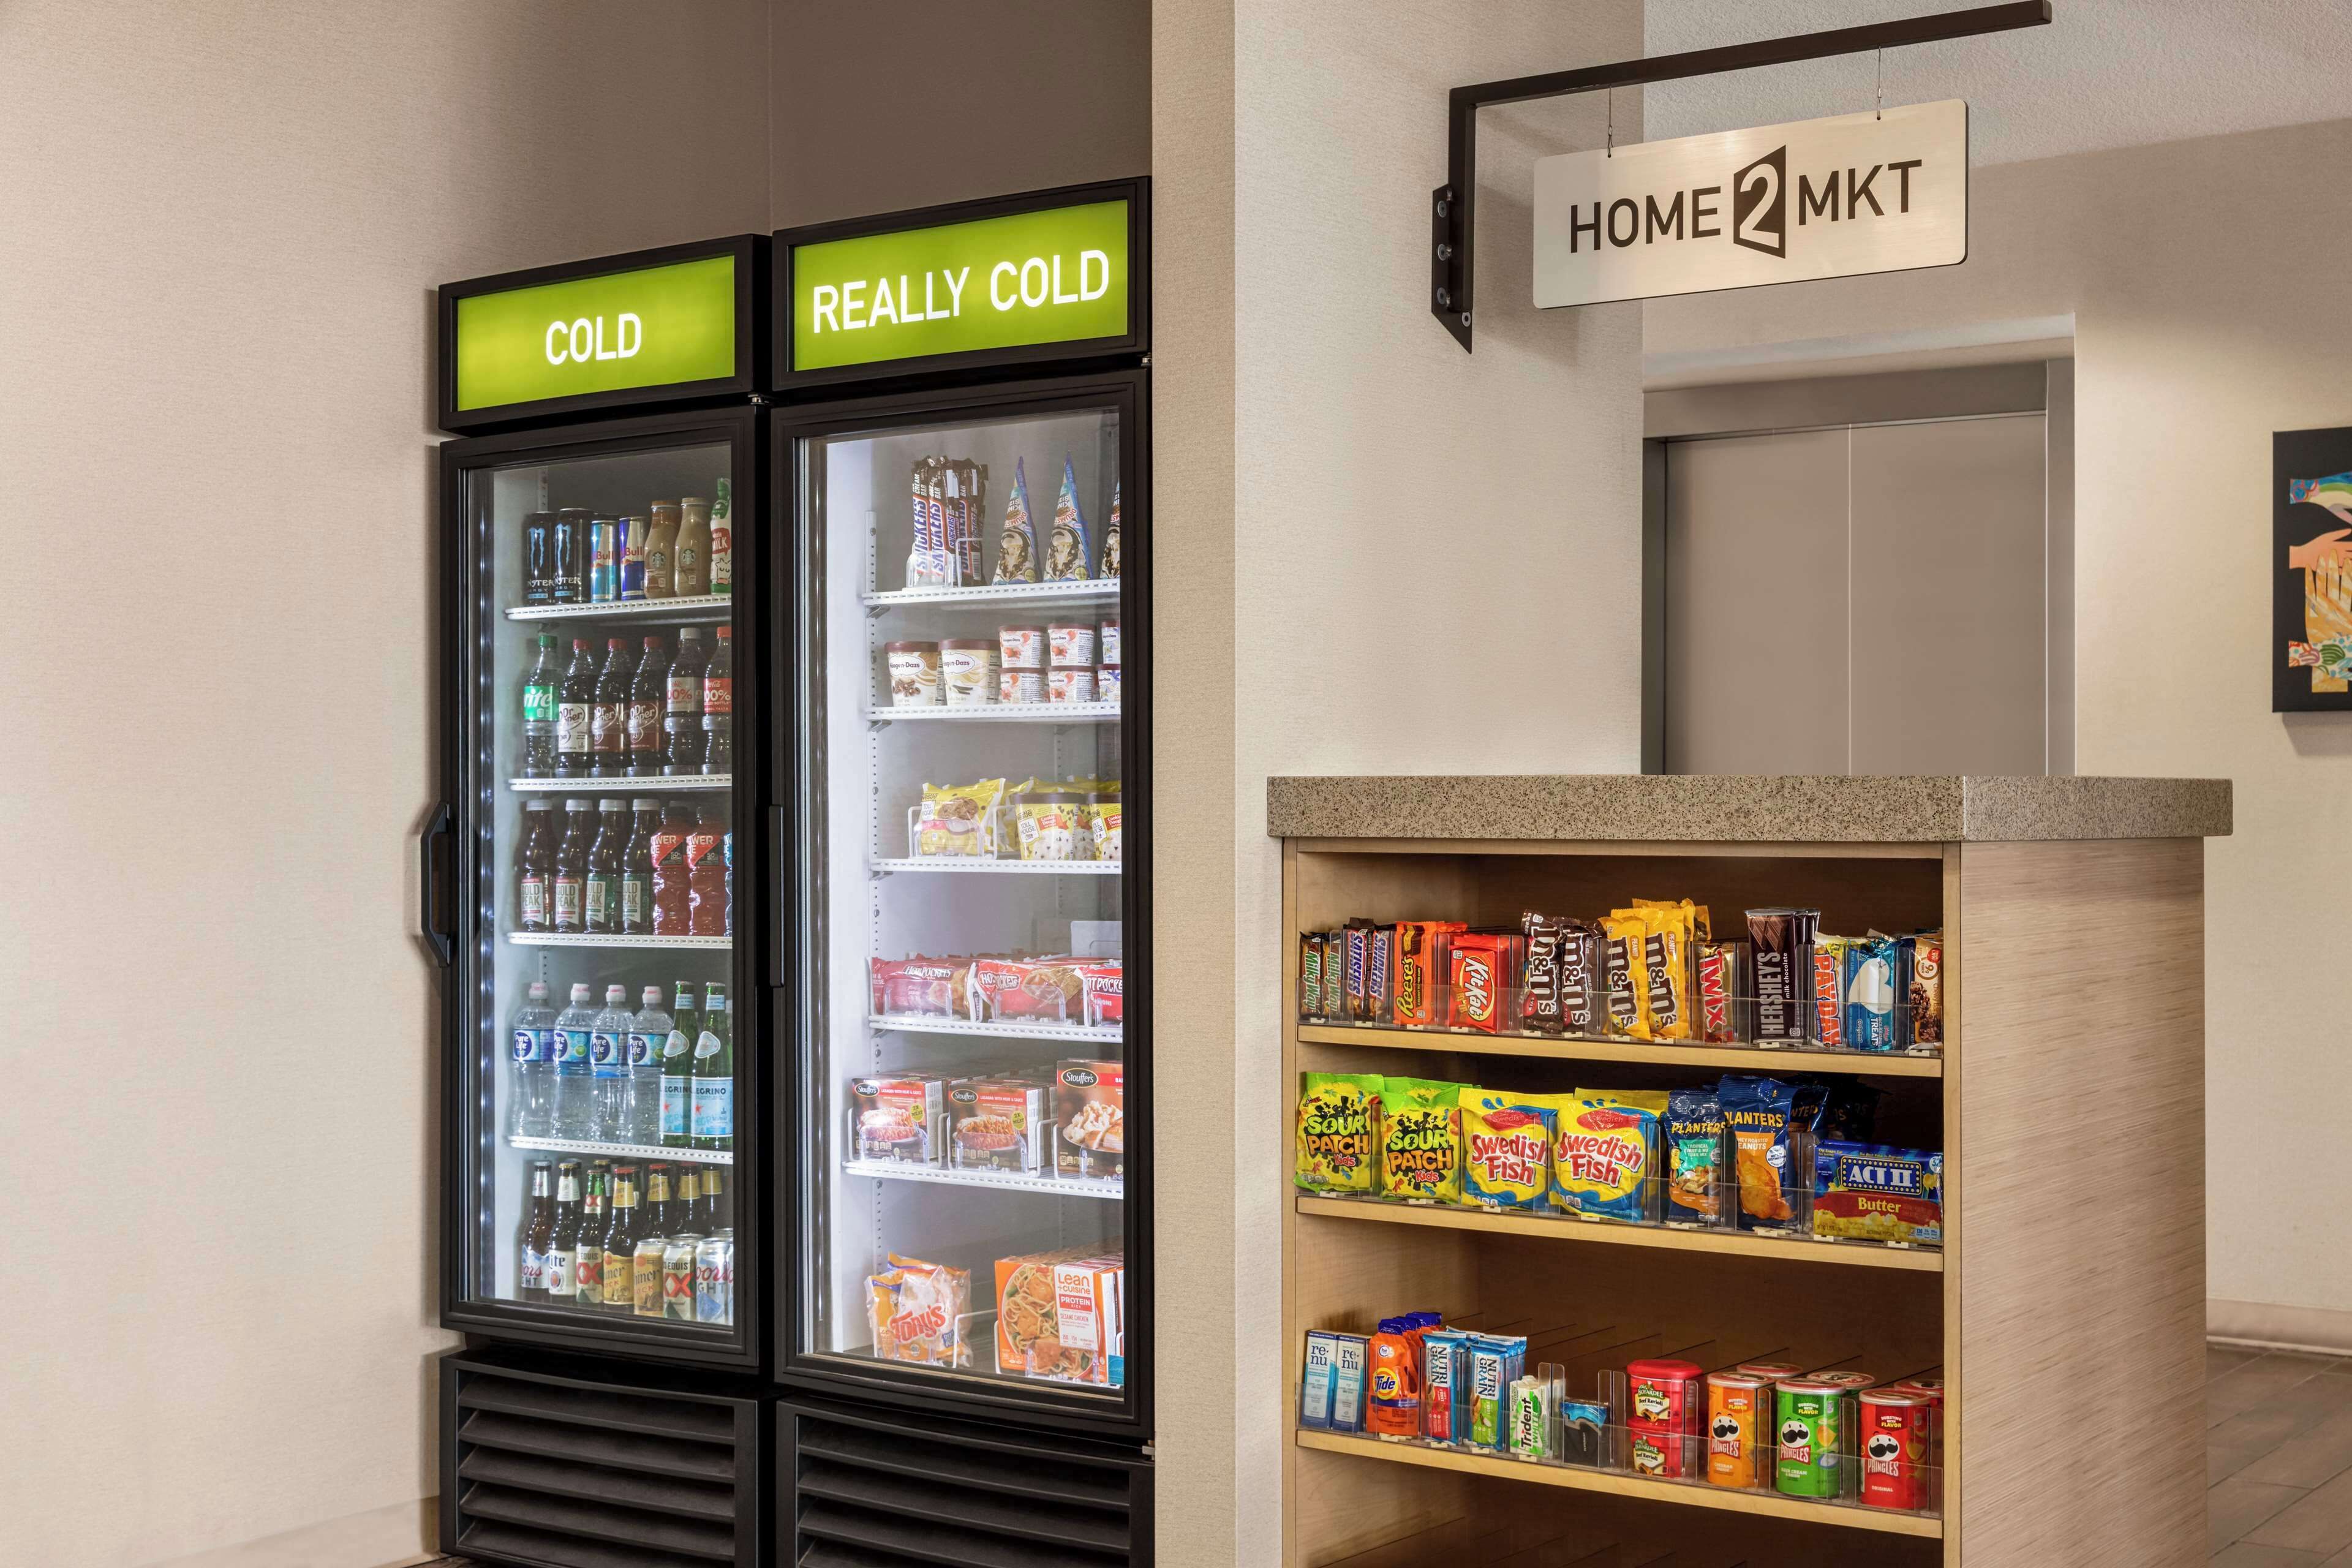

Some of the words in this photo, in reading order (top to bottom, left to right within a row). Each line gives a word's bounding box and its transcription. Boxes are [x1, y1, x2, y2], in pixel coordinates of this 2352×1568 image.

[1570, 186, 1721, 254] HOME
[1798, 159, 1922, 226] MKT
[813, 266, 971, 334] REALLY
[990, 249, 1110, 311] COLD
[545, 312, 642, 366] COLD
[913, 497, 929, 570] SNICKERS
[930, 500, 944, 574] SNICKERS
[596, 551, 615, 560] Bull
[625, 546, 643, 556] Bull
[1304, 951, 1321, 984] Milky
[1325, 951, 1340, 984] Milky
[1370, 933, 1387, 998] SNICKERS
[1465, 957, 1488, 987] Kit
[1303, 981, 1321, 1010] Way
[1396, 955, 1414, 1017] Reese's
[1700, 949, 1727, 1031] TWIX
[1758, 952, 1785, 1035] HERSHEY'S
[1464, 982, 1488, 1017] Kat
[1814, 954, 1842, 1046] PAYDAY
[554, 1034, 565, 1042] Pure
[1870, 1017, 1879, 1046] TREATS
[630, 1045, 641, 1054] Life
[1066, 1072, 1094, 1084] Stouffer's
[955, 1092, 975, 1101] Stouffer's
[1306, 1115, 1365, 1135] SOUR
[1671, 1121, 1725, 1134] PLANTERS
[1308, 1135, 1370, 1155] PATCH
[1390, 1129, 1449, 1151] SOUR
[1471, 1133, 1552, 1167] Swedish
[1557, 1132, 1643, 1172] Swedish
[1333, 1153, 1356, 1167] Kids
[1387, 1149, 1452, 1173] PATCH
[1485, 1156, 1535, 1186] Fish
[1568, 1154, 1620, 1188] Fish
[1415, 1169, 1440, 1183] Kids
[1849, 1165, 1889, 1186] ACT
[1890, 1168, 1913, 1187] II
[1857, 1197, 1902, 1213] Butter
[668, 1262, 688, 1270] EQUIS
[1058, 1273, 1090, 1287] Lean
[1060, 1296, 1090, 1306] PROTEIN
[889, 1305, 946, 1343] Tony's
[1310, 1355, 1328, 1366] nu
[1341, 1359, 1359, 1371] nu
[1430, 1345, 1440, 1384] GRAIN
[1437, 1346, 1448, 1384] NUTRI
[1374, 1376, 1396, 1392] Tide
[1478, 1357, 1488, 1396] GRAIN
[1486, 1358, 1497, 1397] NUTRI
[1638, 1389, 1665, 1399] BOYARDEE
[1521, 1397, 1532, 1447] Trident
[1643, 1453, 1658, 1461] Ravioli
[1711, 1439, 1740, 1457] PRINGLES
[1780, 1444, 1809, 1464] PRINGLES
[1868, 1460, 1899, 1477] PRINGLES
